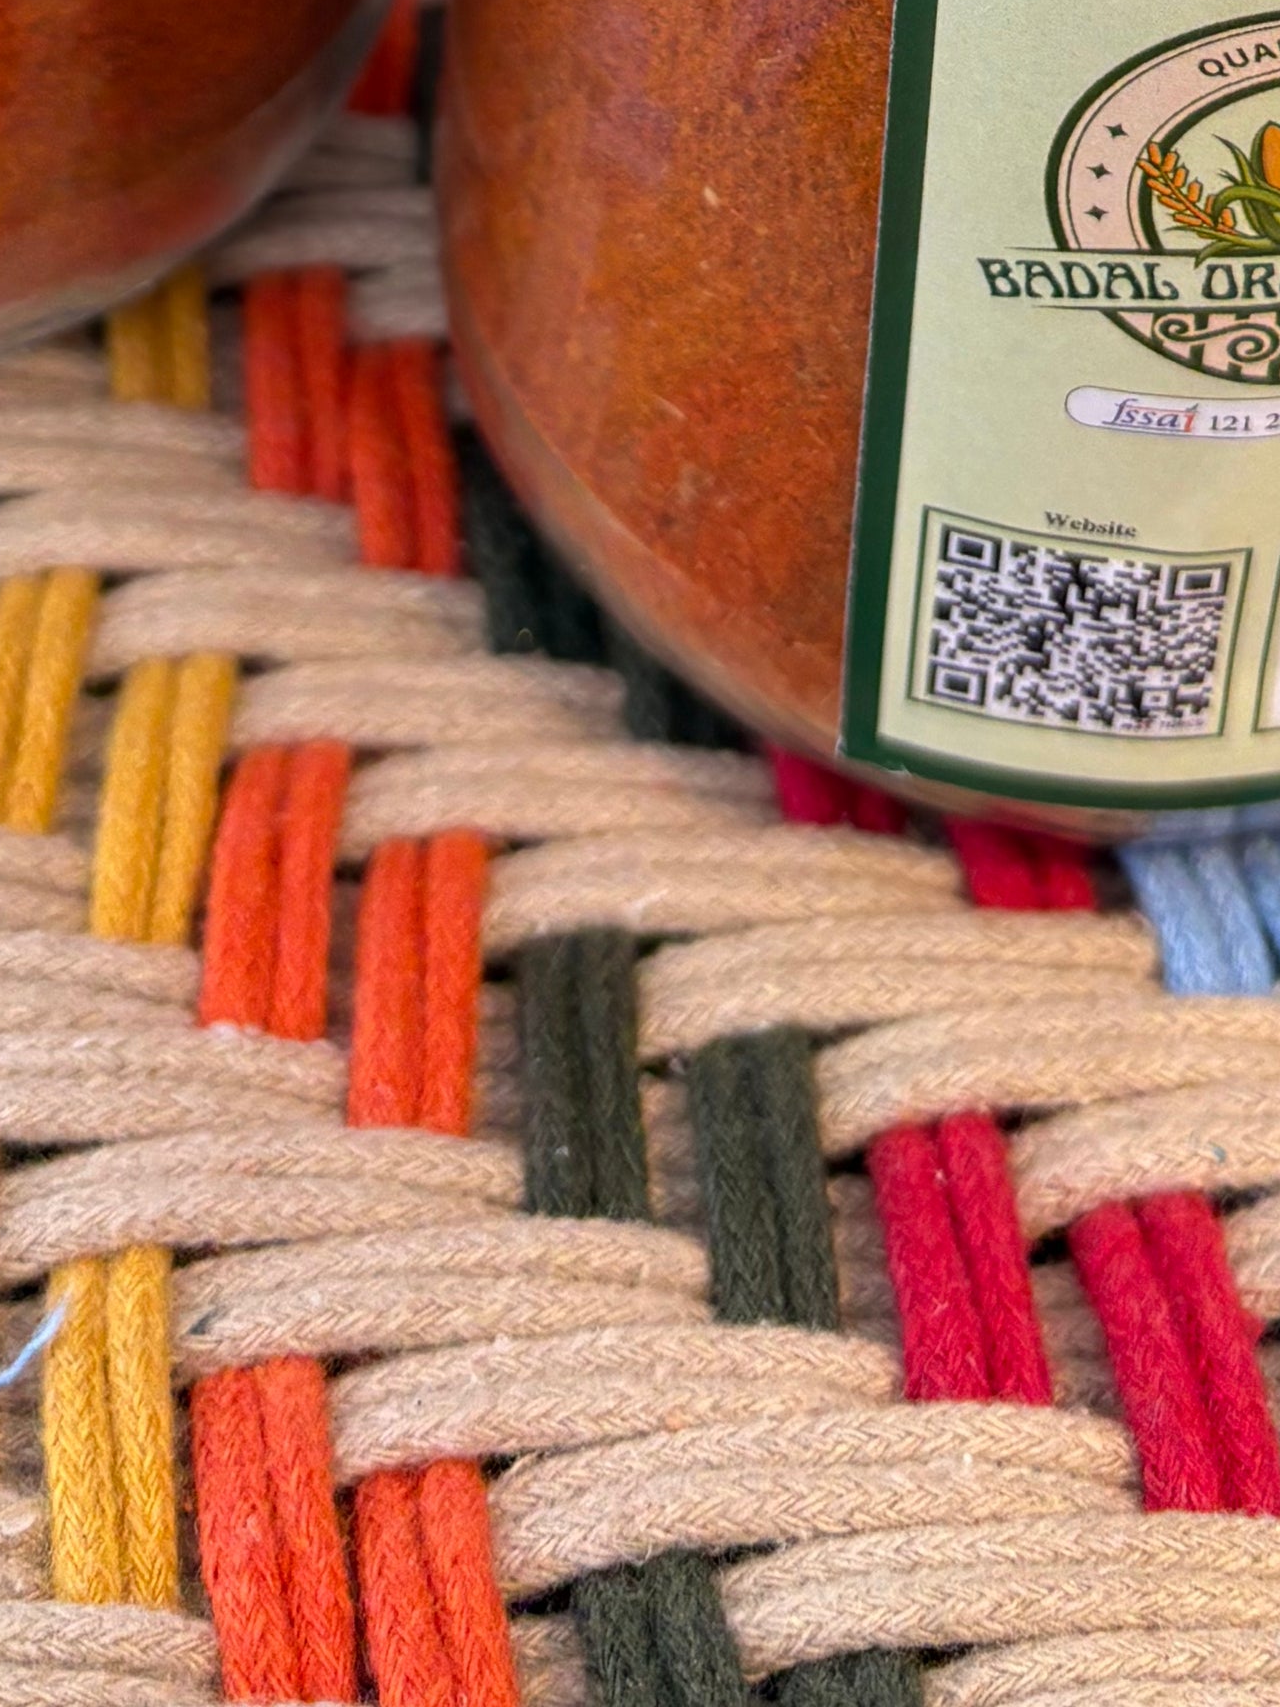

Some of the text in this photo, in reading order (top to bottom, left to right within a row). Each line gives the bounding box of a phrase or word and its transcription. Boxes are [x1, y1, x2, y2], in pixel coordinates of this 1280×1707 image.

[977, 256, 1180, 300] BADAL
[1208, 414, 1254, 433] 121
[1043, 509, 1139, 539] Website
